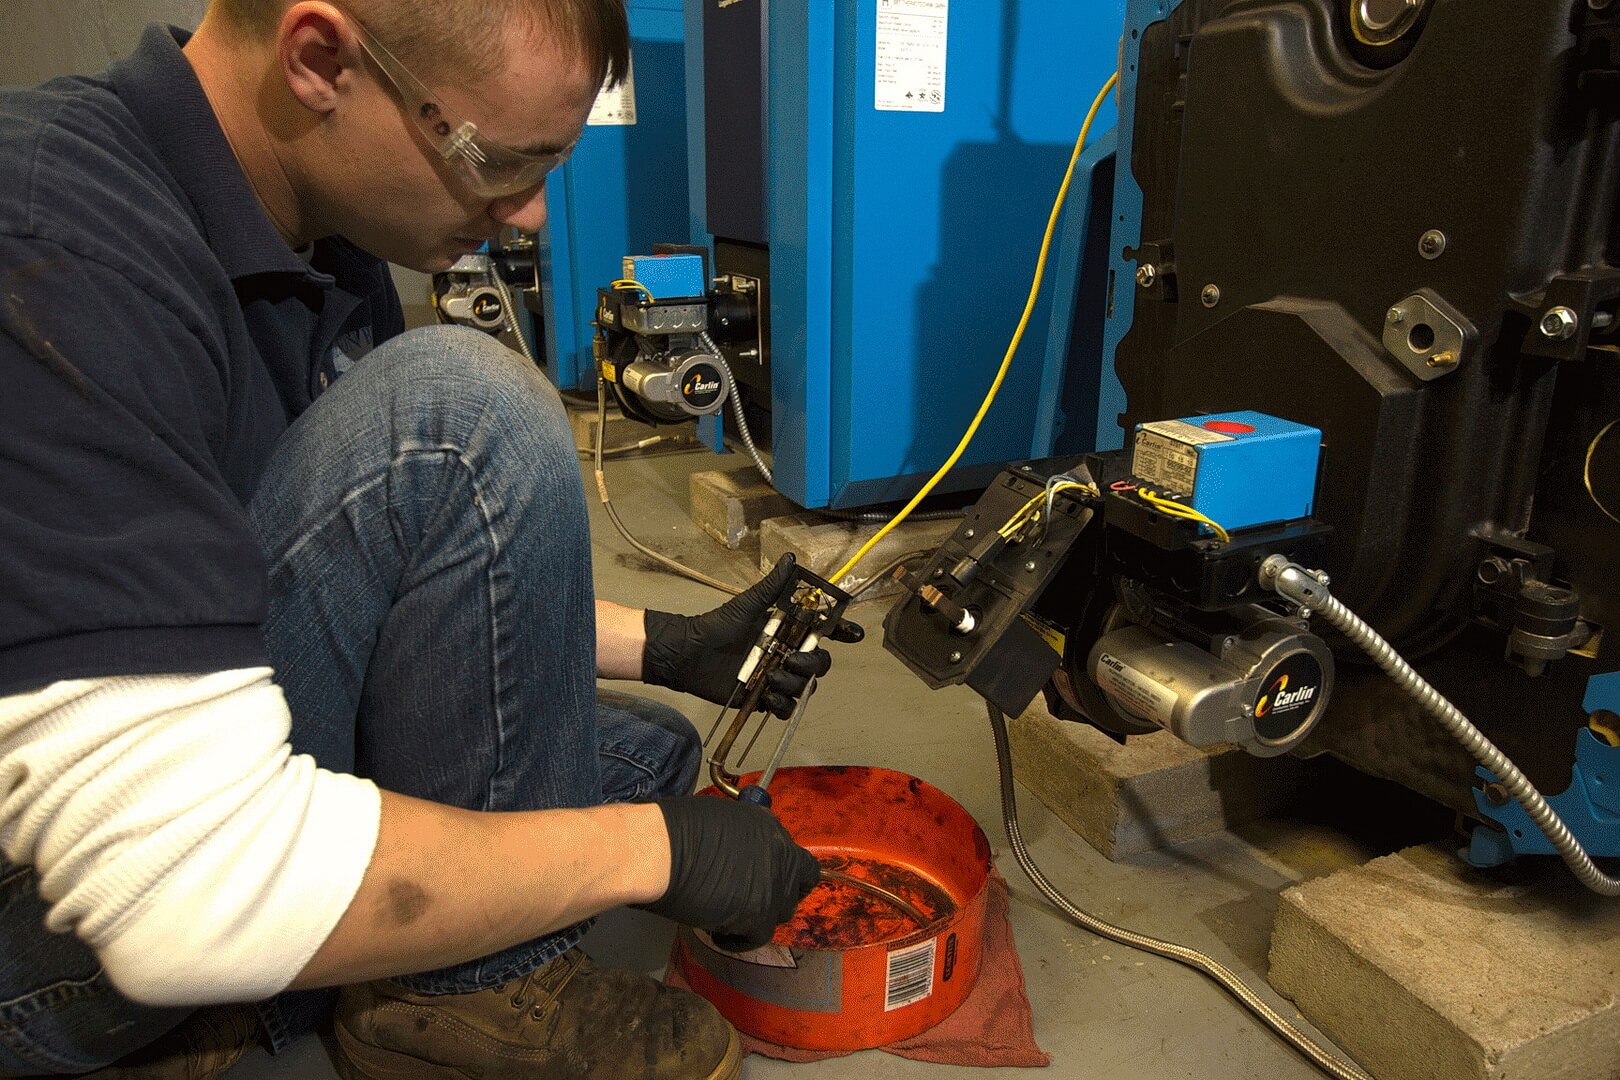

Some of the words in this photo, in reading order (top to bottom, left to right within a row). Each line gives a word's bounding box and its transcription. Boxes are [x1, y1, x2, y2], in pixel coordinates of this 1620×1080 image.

[695, 381, 718, 391] Carlin
[1141, 438, 1162, 449] Carlin
[1100, 654, 1124, 672] Carlin
[1274, 686, 1314, 707] Carlin
